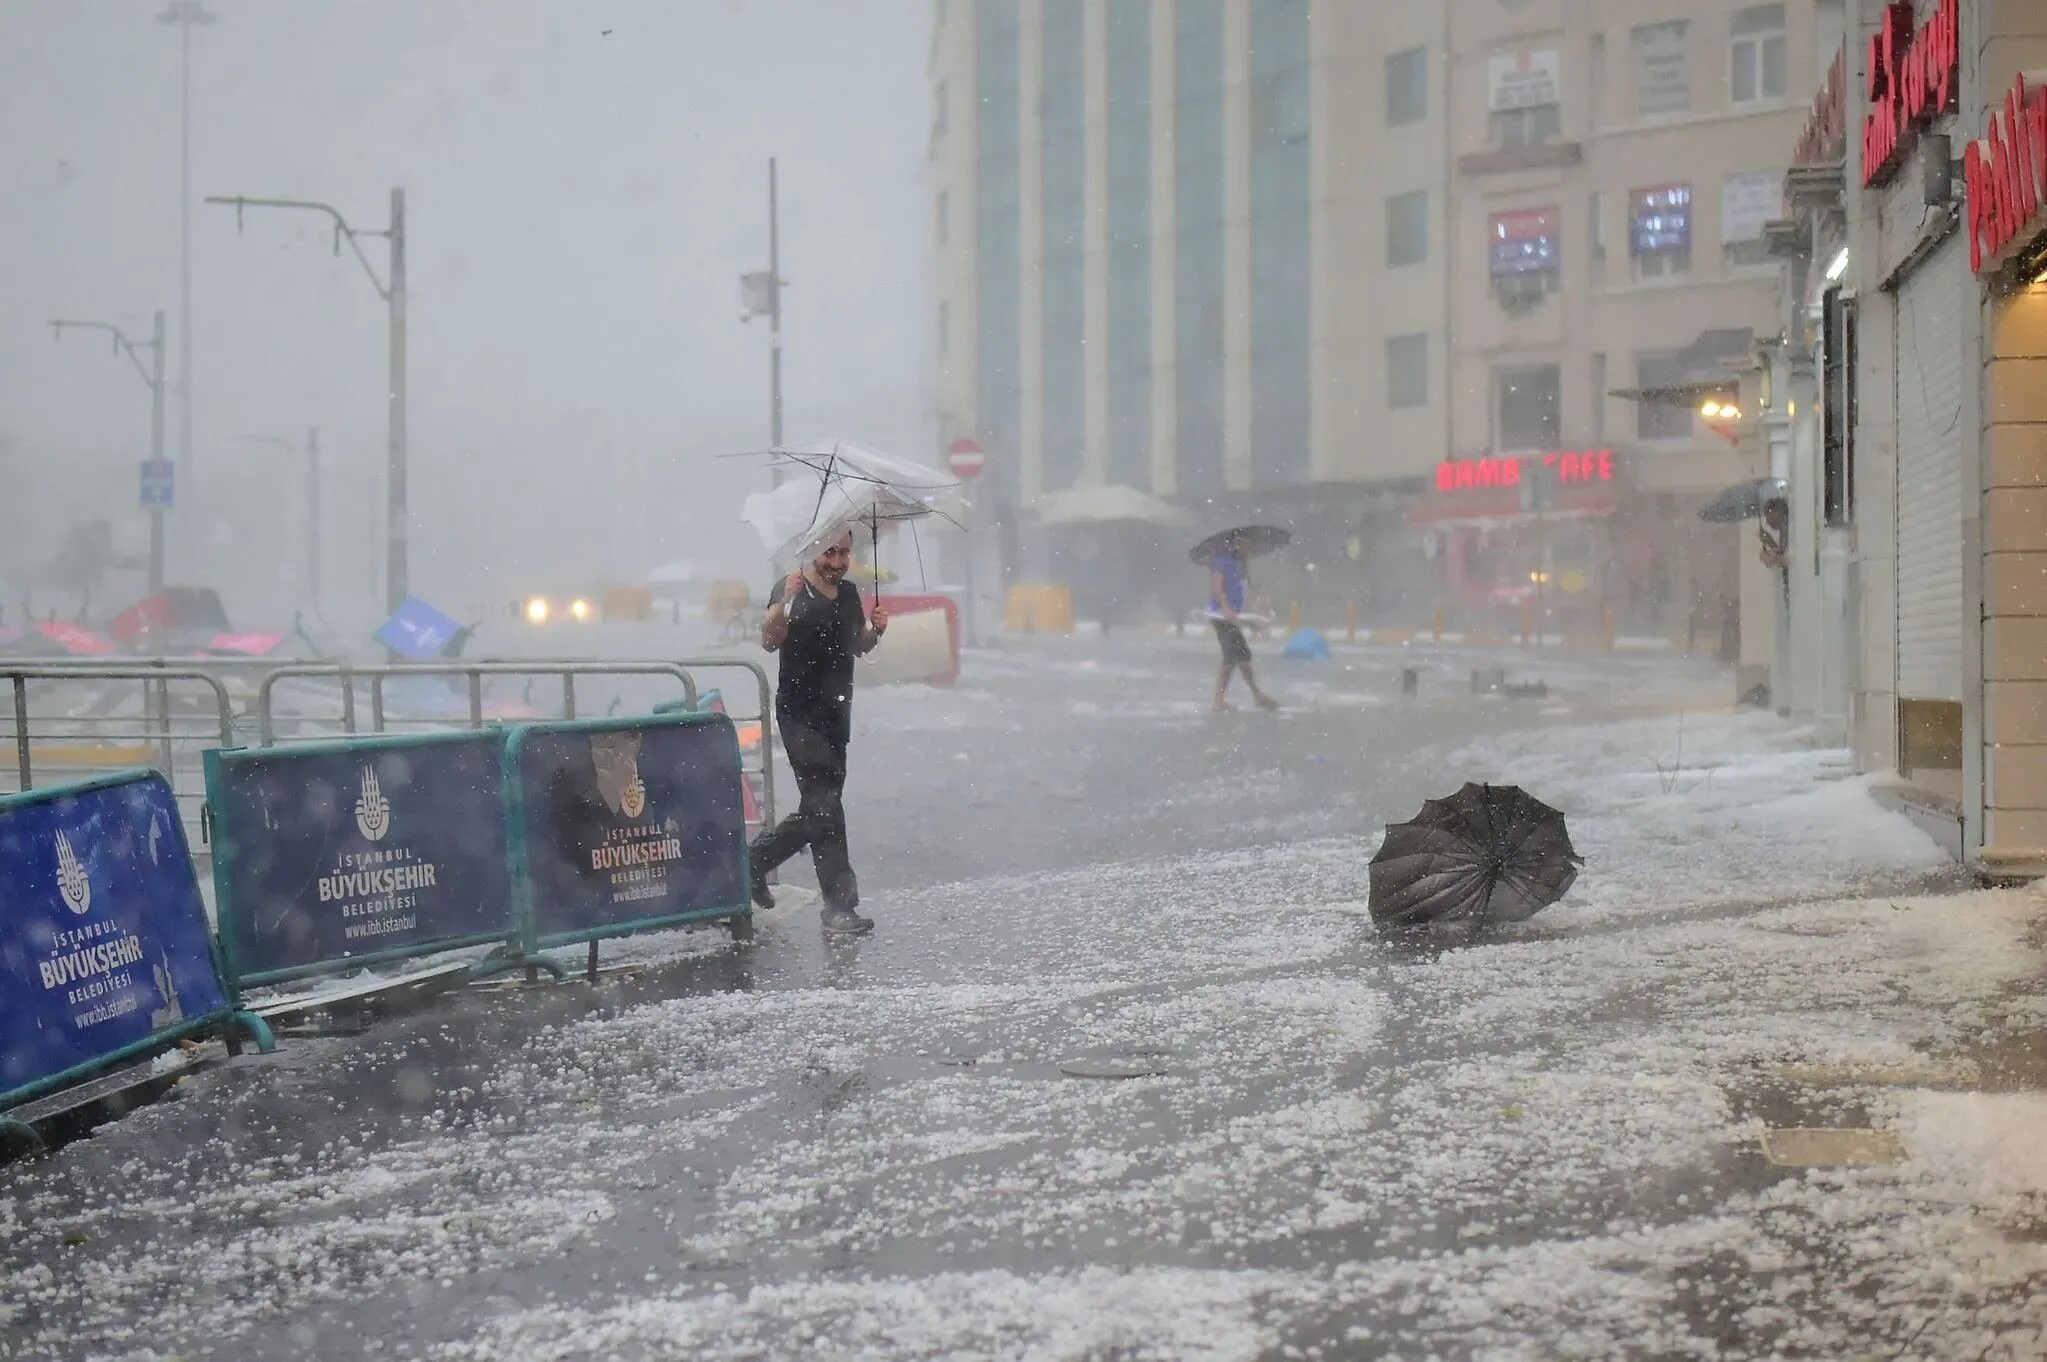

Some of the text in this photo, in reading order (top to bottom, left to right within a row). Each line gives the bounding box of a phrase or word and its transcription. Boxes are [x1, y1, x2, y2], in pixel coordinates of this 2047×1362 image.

[1436, 458, 1521, 491] BAMB
[338, 847, 412, 869] İSTANBUL
[592, 834, 682, 870] BÜYÜKŞEHİR
[318, 858, 436, 902] BÜYÜKŞEHİR
[611, 865, 666, 884] BELEDİYESİ
[342, 893, 416, 917] BELEDİYESİ
[53, 919, 118, 948] İSTANBUL
[344, 912, 416, 939] www.ibb.istanbul
[39, 930, 143, 989] BÜYÜKŞEHİR
[68, 969, 133, 1004] BELEDİYESİ
